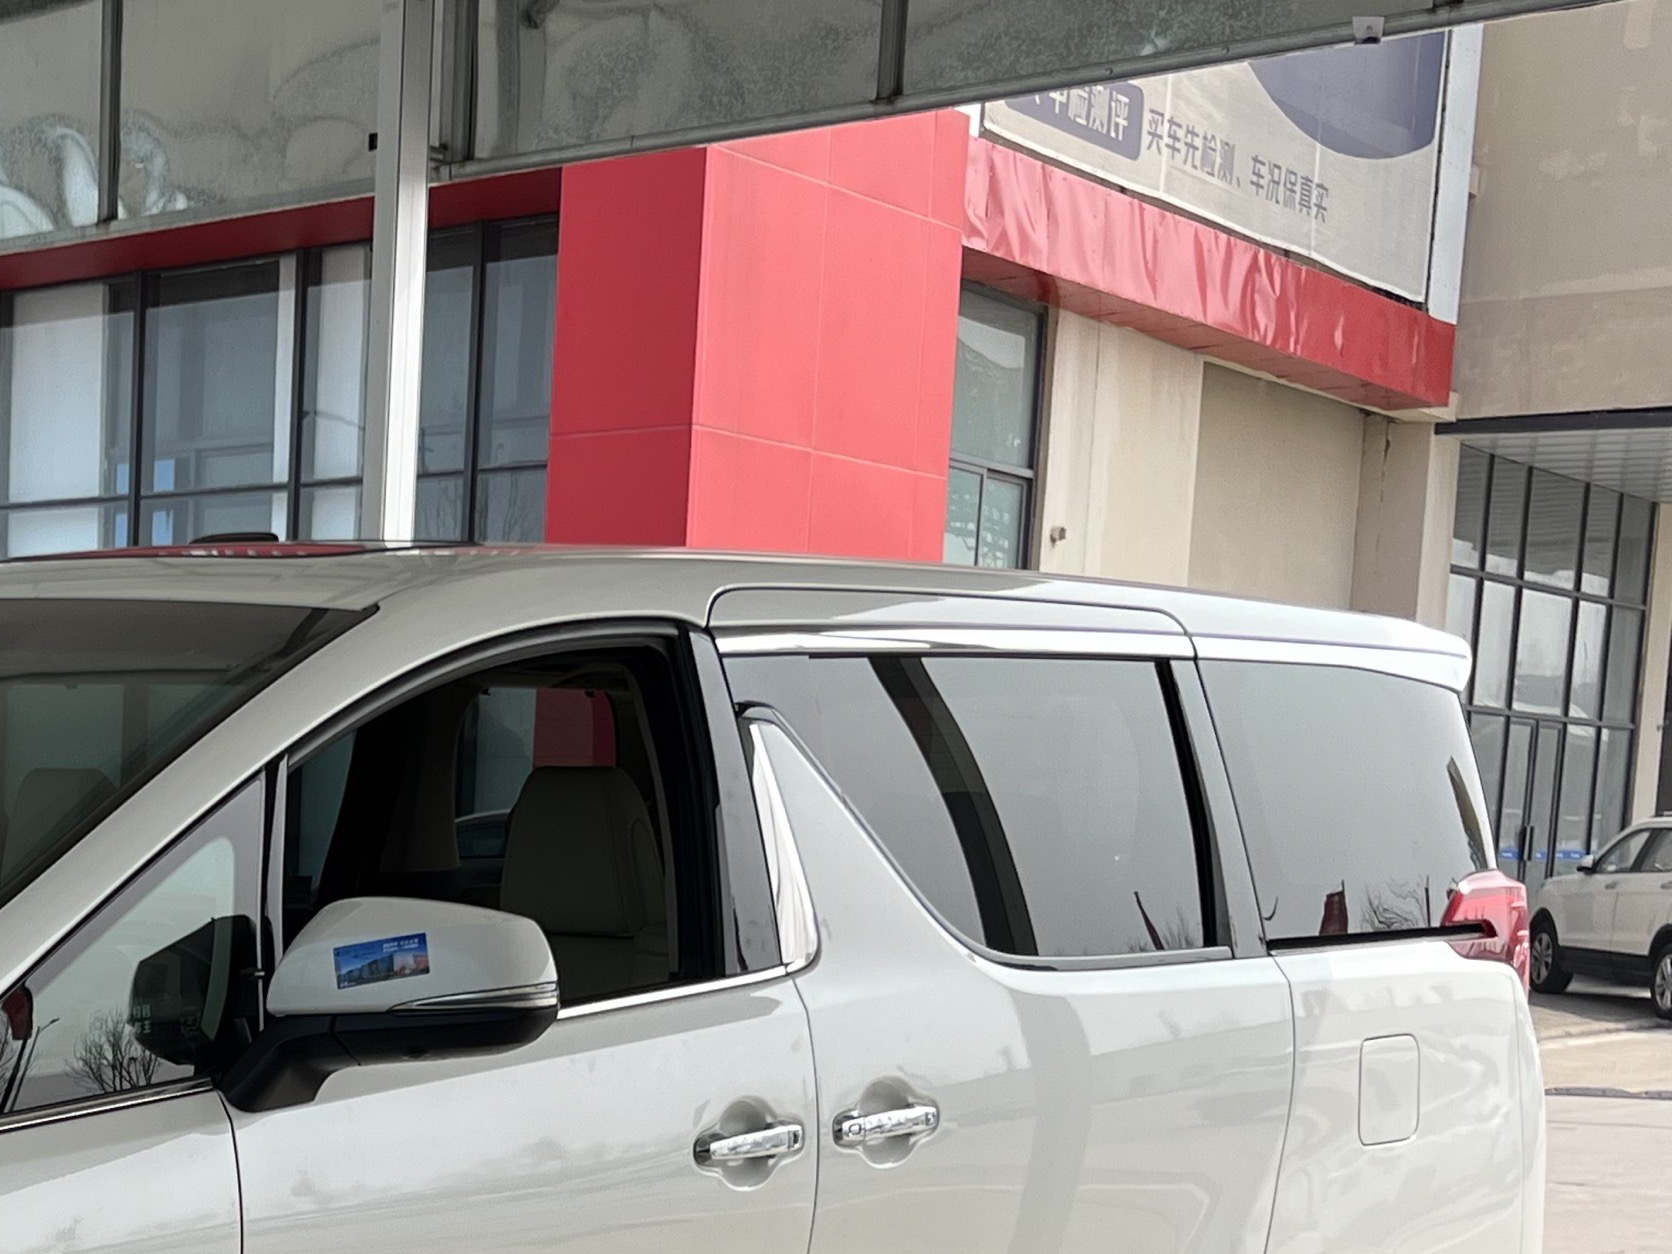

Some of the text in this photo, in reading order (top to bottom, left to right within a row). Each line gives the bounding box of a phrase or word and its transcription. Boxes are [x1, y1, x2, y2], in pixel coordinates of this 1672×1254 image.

[1146, 108, 1329, 224] 买车先检测、车况保真实
